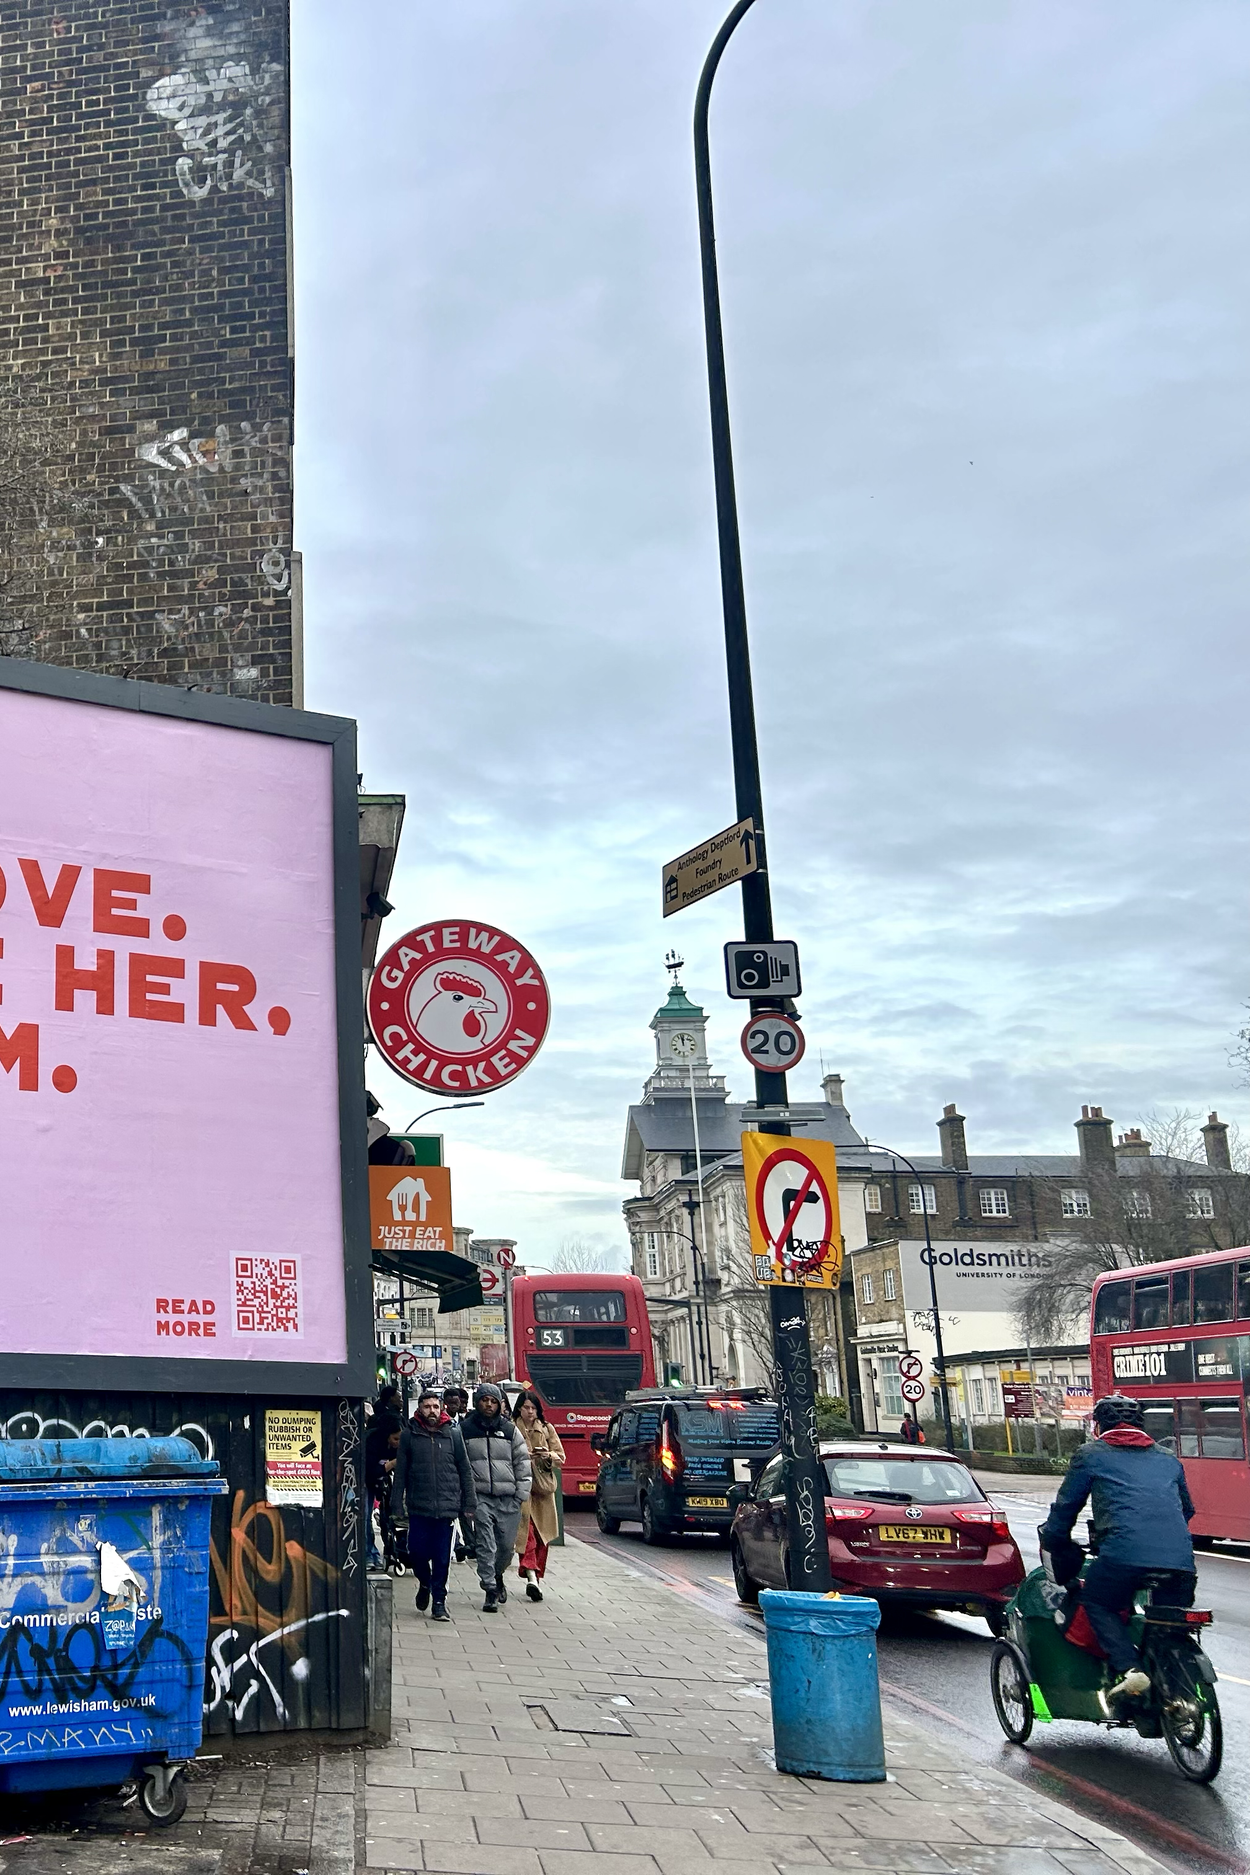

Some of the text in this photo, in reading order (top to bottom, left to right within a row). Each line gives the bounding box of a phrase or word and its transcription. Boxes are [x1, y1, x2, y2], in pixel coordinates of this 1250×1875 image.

[677, 827, 741, 872] Anthology Deptford
[695, 858, 723, 878] Foundry
[682, 867, 739, 902] Pedestrian Route
[380, 926, 540, 989] GATEWAY
[55, 945, 290, 1035] HER,
[749, 1029, 797, 1056] 20
[382, 1024, 537, 1088] CHICKEN
[377, 1226, 443, 1239] JUST EAT
[384, 1238, 446, 1251] THE RICH
[500, 1250, 513, 1265] N
[919, 1247, 1052, 1268] Goldsmiths
[956, 1271, 1003, 1279] UNIVERSITY
[155, 1298, 216, 1315] READ
[155, 1320, 216, 1337] MORE
[542, 1330, 563, 1346] 53
[1114, 1352, 1167, 1378] CRIME 101
[905, 1384, 922, 1395] 20
[268, 1416, 317, 1426] NO DUMPING
[268, 1425, 313, 1434] RUBBISH OR
[680, 1410, 724, 1432] KSM
[268, 1434, 311, 1442] UNWANTED
[268, 1442, 292, 1451] ITEMS
[885, 1527, 917, 1540] LV67
[8, 1693, 157, 1718] www.lewisham.gov.uk
